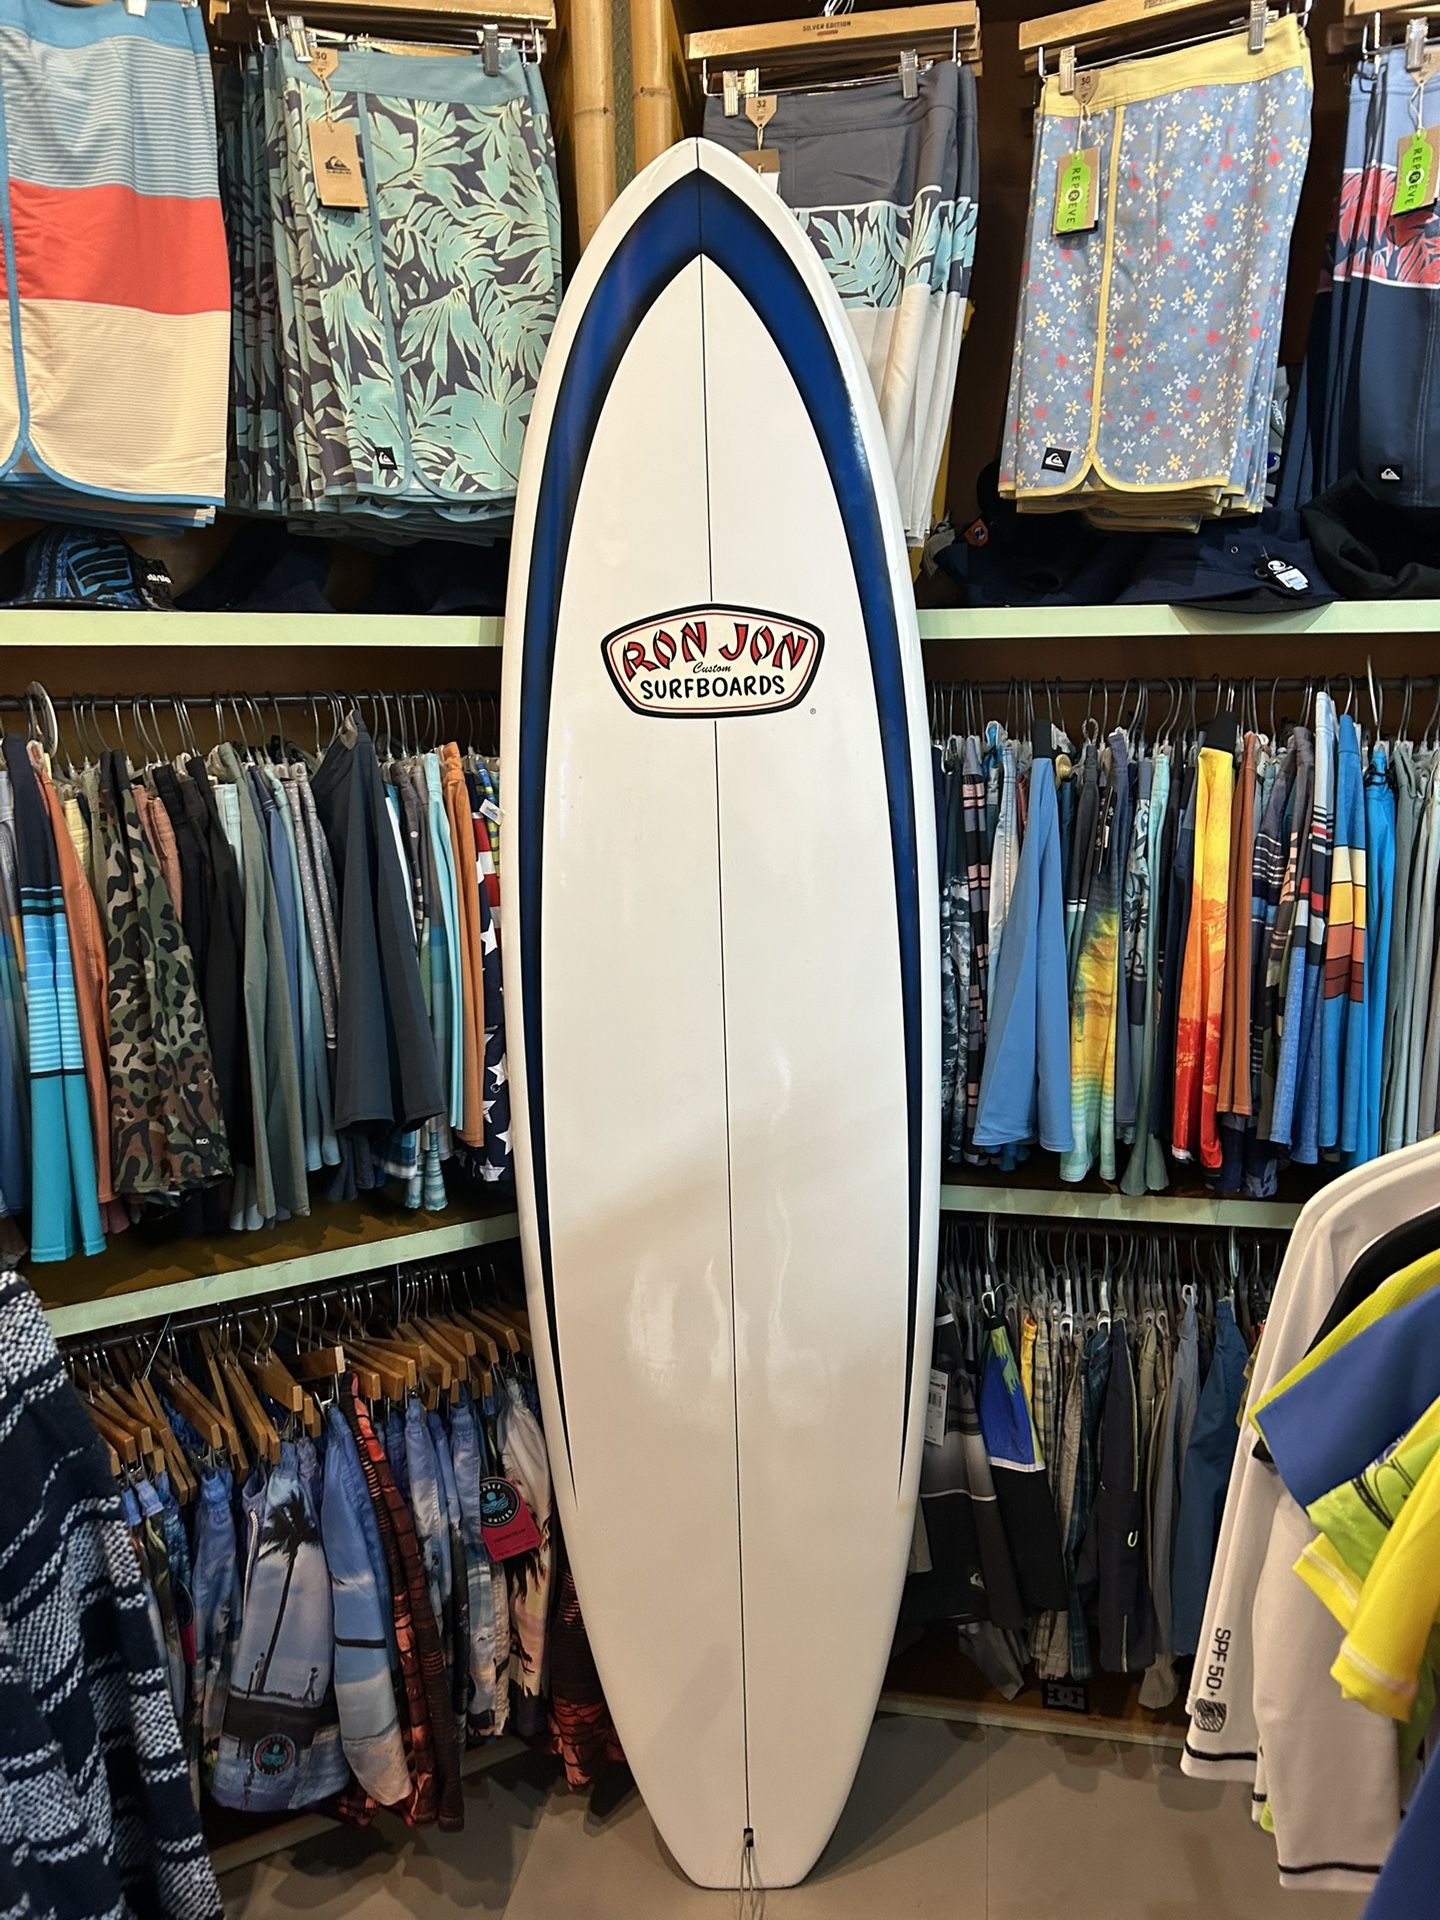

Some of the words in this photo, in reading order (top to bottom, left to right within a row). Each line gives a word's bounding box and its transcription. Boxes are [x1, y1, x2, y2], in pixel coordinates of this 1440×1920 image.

[802, 22, 825, 32] SILVER
[826, 20, 851, 29] EDITION
[314, 50, 327, 61] 30
[757, 99, 767, 108] 32
[1405, 147, 1423, 205] REPREVE
[1066, 167, 1081, 224] REPREVE
[622, 620, 708, 682] RON
[718, 622, 809, 672] JON
[692, 661, 733, 674] Custom
[639, 674, 786, 700] SURFBOARDS
[1211, 1627, 1231, 1663] SPF
[1205, 1664, 1225, 1697] 50+
